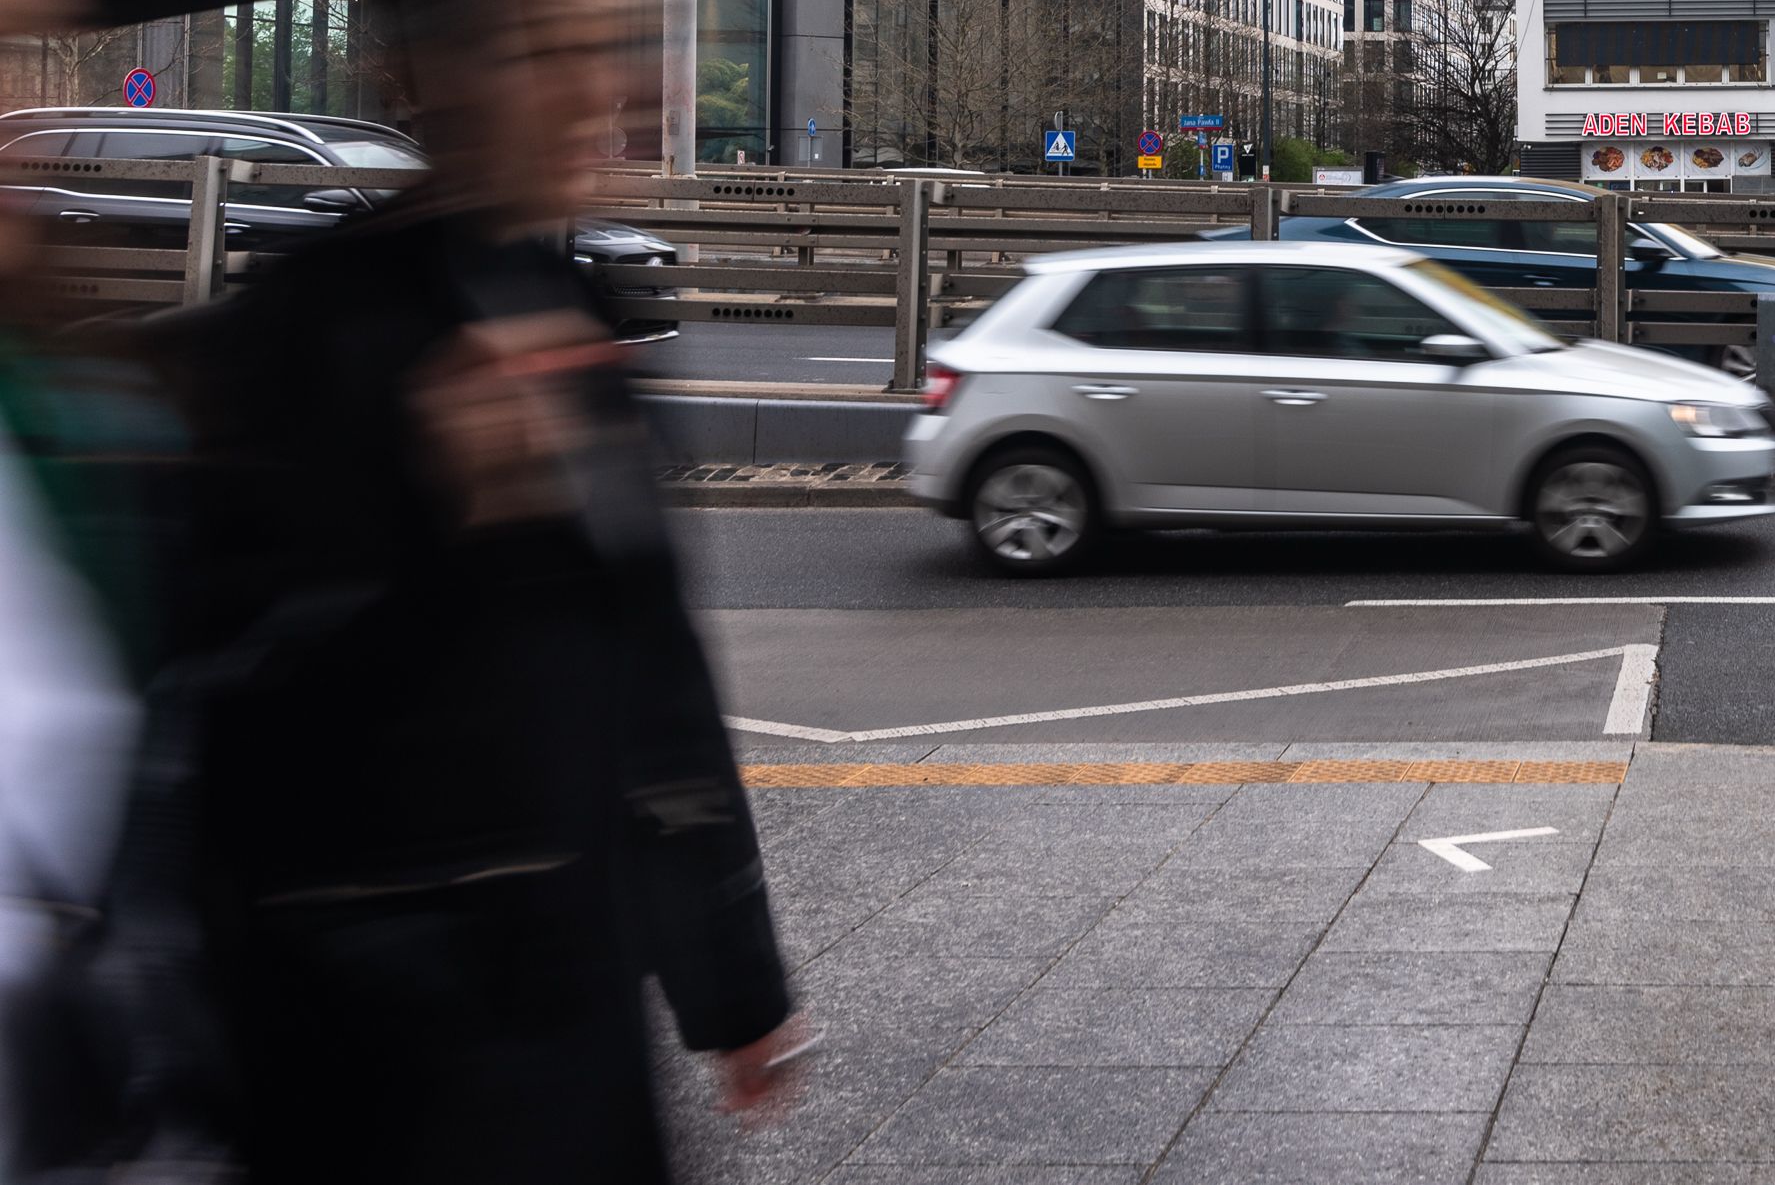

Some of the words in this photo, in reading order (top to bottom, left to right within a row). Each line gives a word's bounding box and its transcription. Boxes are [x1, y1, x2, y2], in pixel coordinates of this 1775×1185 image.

[1582, 112, 1648, 136] ADEN
[1663, 112, 1751, 136] KEBAB
[1217, 146, 1230, 164] P
